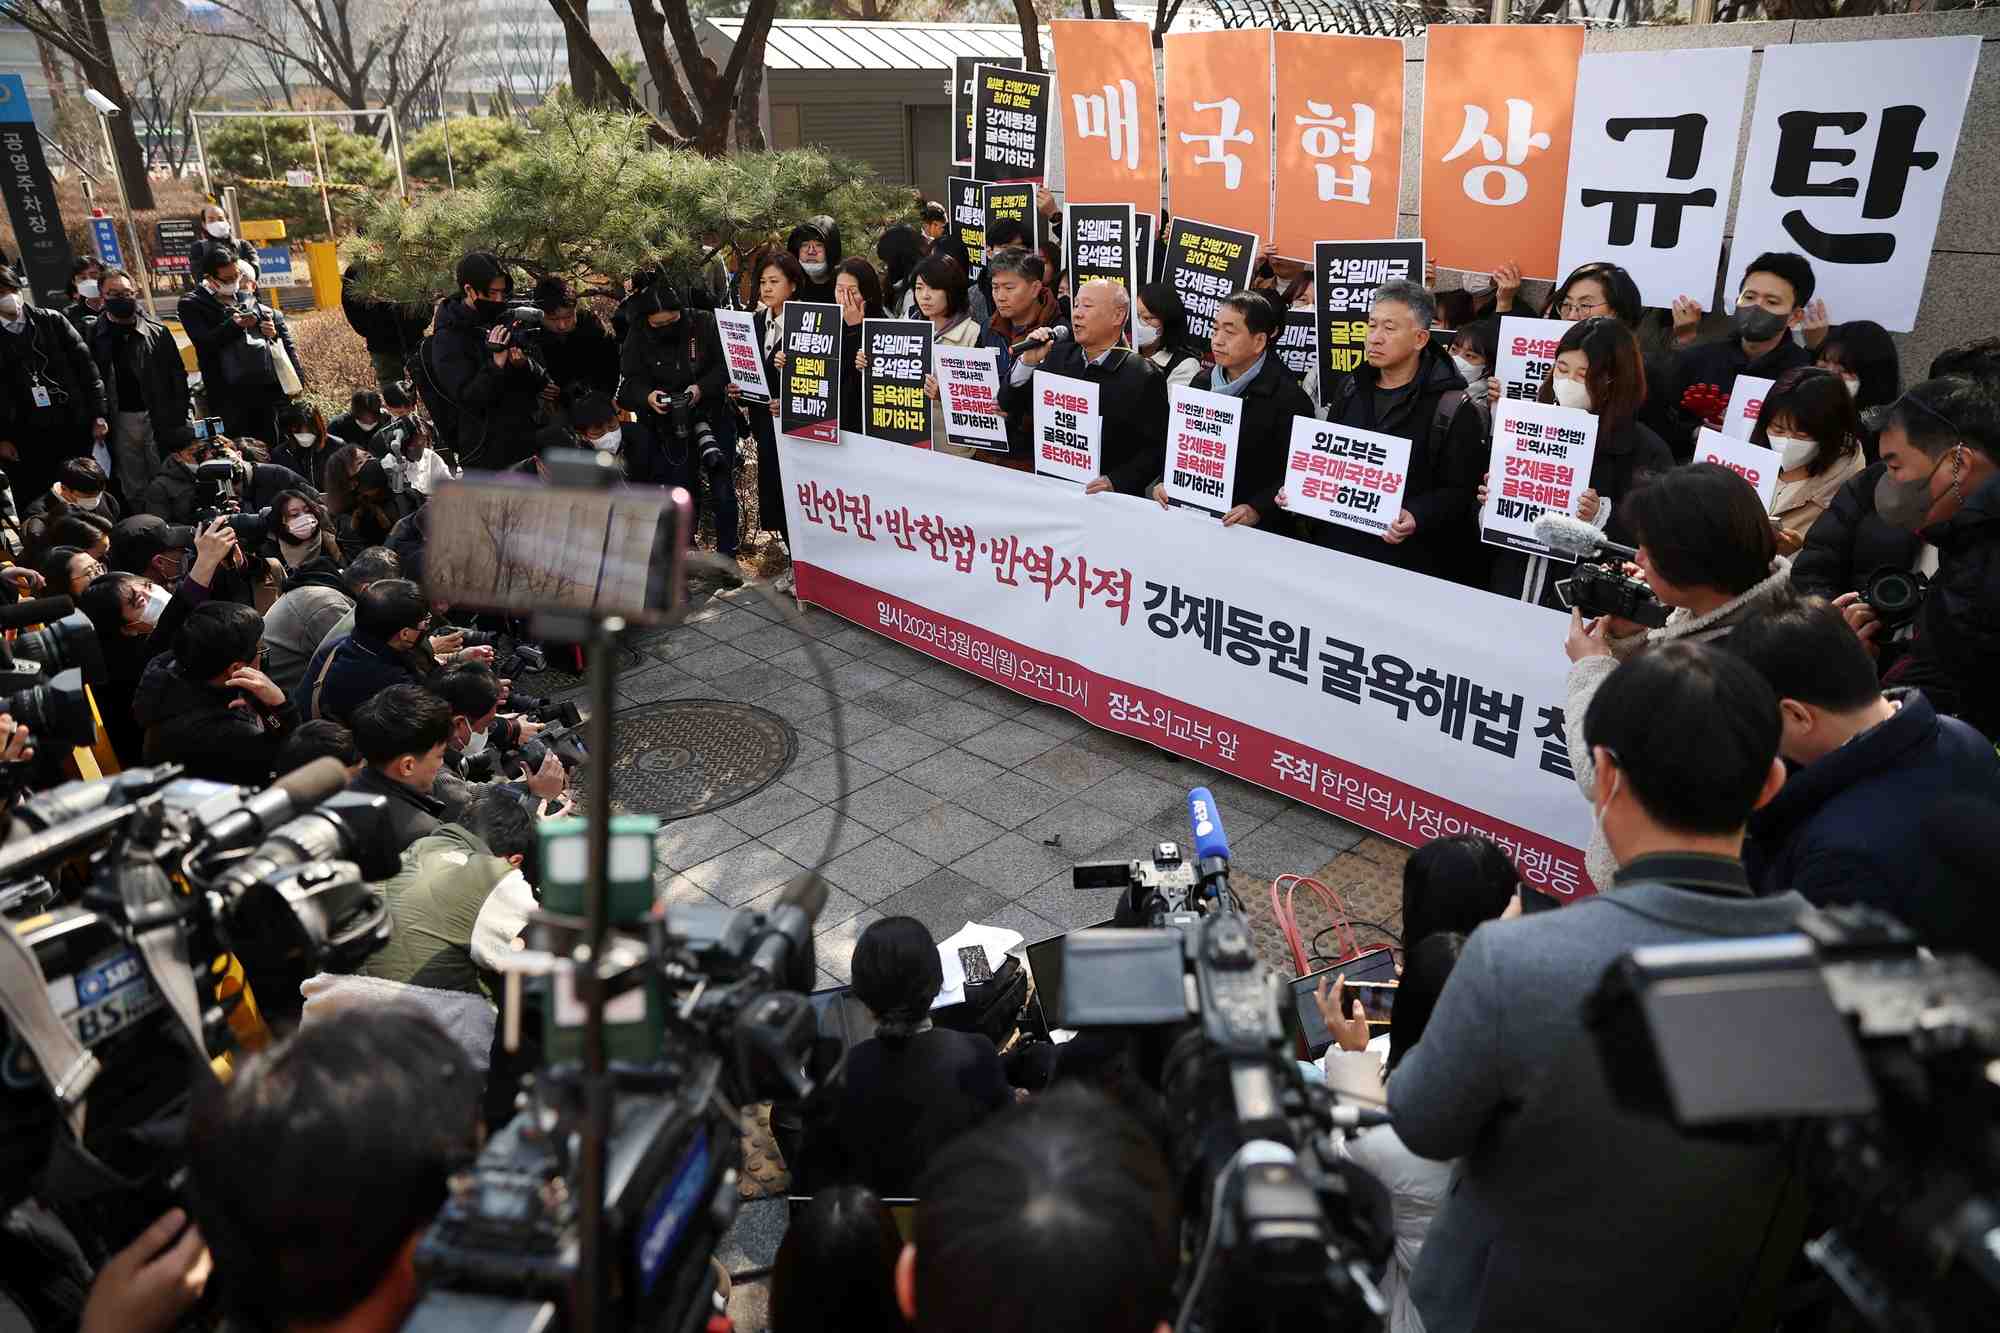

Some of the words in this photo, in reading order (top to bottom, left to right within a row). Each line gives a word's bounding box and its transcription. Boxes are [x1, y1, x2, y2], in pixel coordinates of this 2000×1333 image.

[985, 107, 1037, 132] 강제동원
[1072, 79, 1139, 170] 매
[985, 126, 1036, 151] 굴욕해법
[1180, 97, 1254, 190] 국
[985, 144, 1035, 168] 폐기하라
[1295, 100, 1376, 205] 협
[1442, 98, 1551, 206] 상
[3, 132, 47, 234] 공영주차장
[1581, 113, 1717, 249] 규
[1771, 105, 1939, 265] 탄
[1077, 219, 1122, 242] 친일매국
[1077, 244, 1122, 268] 윤석열은
[1180, 232, 1201, 249] 일본
[1202, 237, 1243, 258] 전범기업
[1185, 249, 1207, 265] 참여
[1208, 255, 1229, 272] 없는
[1329, 258, 1409, 284] 친일매국
[1174, 267, 1233, 298] 강제동원
[789, 332, 833, 354] 대통령이
[872, 334, 923, 356] 친일매국
[1331, 321, 1369, 345] 굴욕
[1511, 337, 1562, 359] 윤석열
[795, 357, 825, 377] 일본에
[872, 358, 923, 380] 윤석열은
[791, 377, 829, 398] 면죄부를
[872, 385, 924, 408] 굴욕해법
[949, 383, 993, 401] 강제동원
[792, 397, 826, 417] 줍니까?
[952, 399, 994, 415] 굴욕해법
[1043, 390, 1089, 415] 윤석열은
[1177, 401, 1204, 417] 반인권!
[1206, 408, 1233, 425] 반헌법!
[872, 408, 925, 431] 폐기하라
[952, 413, 998, 430] 폐기하라!
[1055, 410, 1077, 430] 친일
[1186, 418, 1222, 437] 반역사적!
[1504, 419, 1543, 437] 반인권!
[1545, 425, 1585, 445] 반헌법!
[1044, 426, 1088, 451] 굴욕외교
[1178, 433, 1227, 460] 강제동원
[1312, 432, 1387, 466] 외교부는
[1516, 438, 1567, 459] 반역사적!
[1042, 443, 1091, 470] 중단하라!
[1177, 452, 1224, 479] 굴욕해법
[1173, 469, 1225, 498] 폐기하라!
[1290, 450, 1402, 494] 굴욕매국협상
[1505, 455, 1574, 487] 강제동원
[1302, 477, 1381, 513] 중단하라!
[1503, 478, 1570, 509] 굴욕해법
[903, 614, 947, 649] 2023년
[948, 631, 970, 660] 3월
[1019, 659, 1053, 690] 오전
[1057, 672, 1088, 706] 11시
[1142, 580, 1311, 686] 강제동원
[1319, 635, 1525, 760] 굴욕해법
[1108, 692, 1150, 726] 장소
[1152, 707, 1213, 750] 외교부
[1217, 731, 1239, 761] 앞
[1270, 749, 1318, 793] 주최
[1192, 800, 1208, 821] AFP
